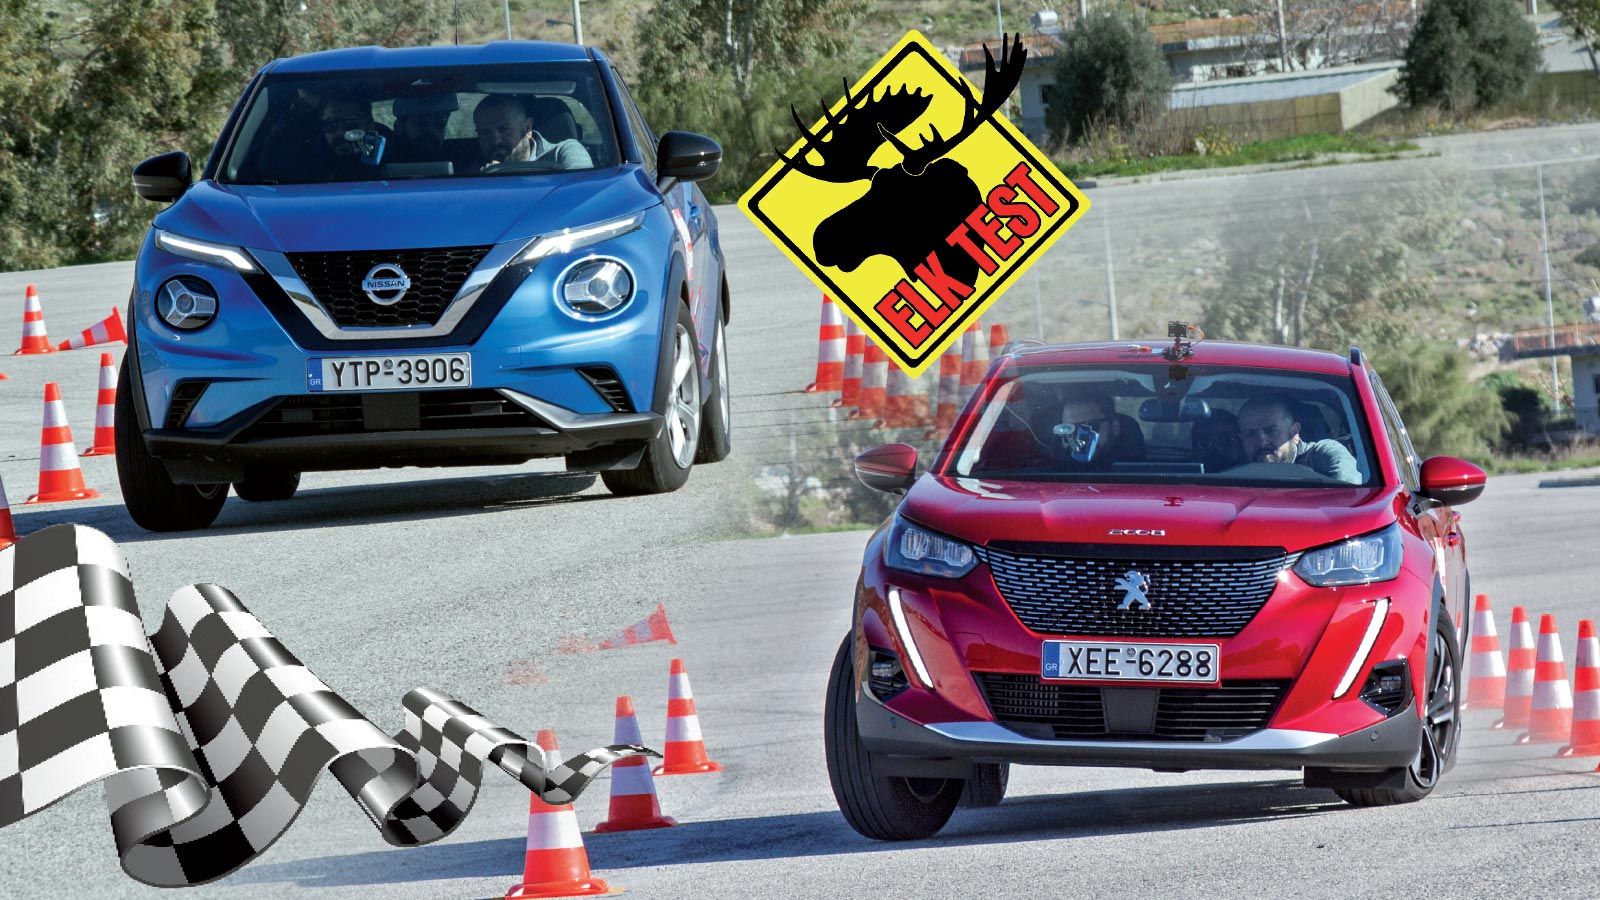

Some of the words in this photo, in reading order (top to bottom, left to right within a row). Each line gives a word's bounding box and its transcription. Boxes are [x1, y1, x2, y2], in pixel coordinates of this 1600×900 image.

[367, 280, 405, 288] NISSAN
[309, 378, 322, 386] GR
[1045, 663, 1058, 671] GR
